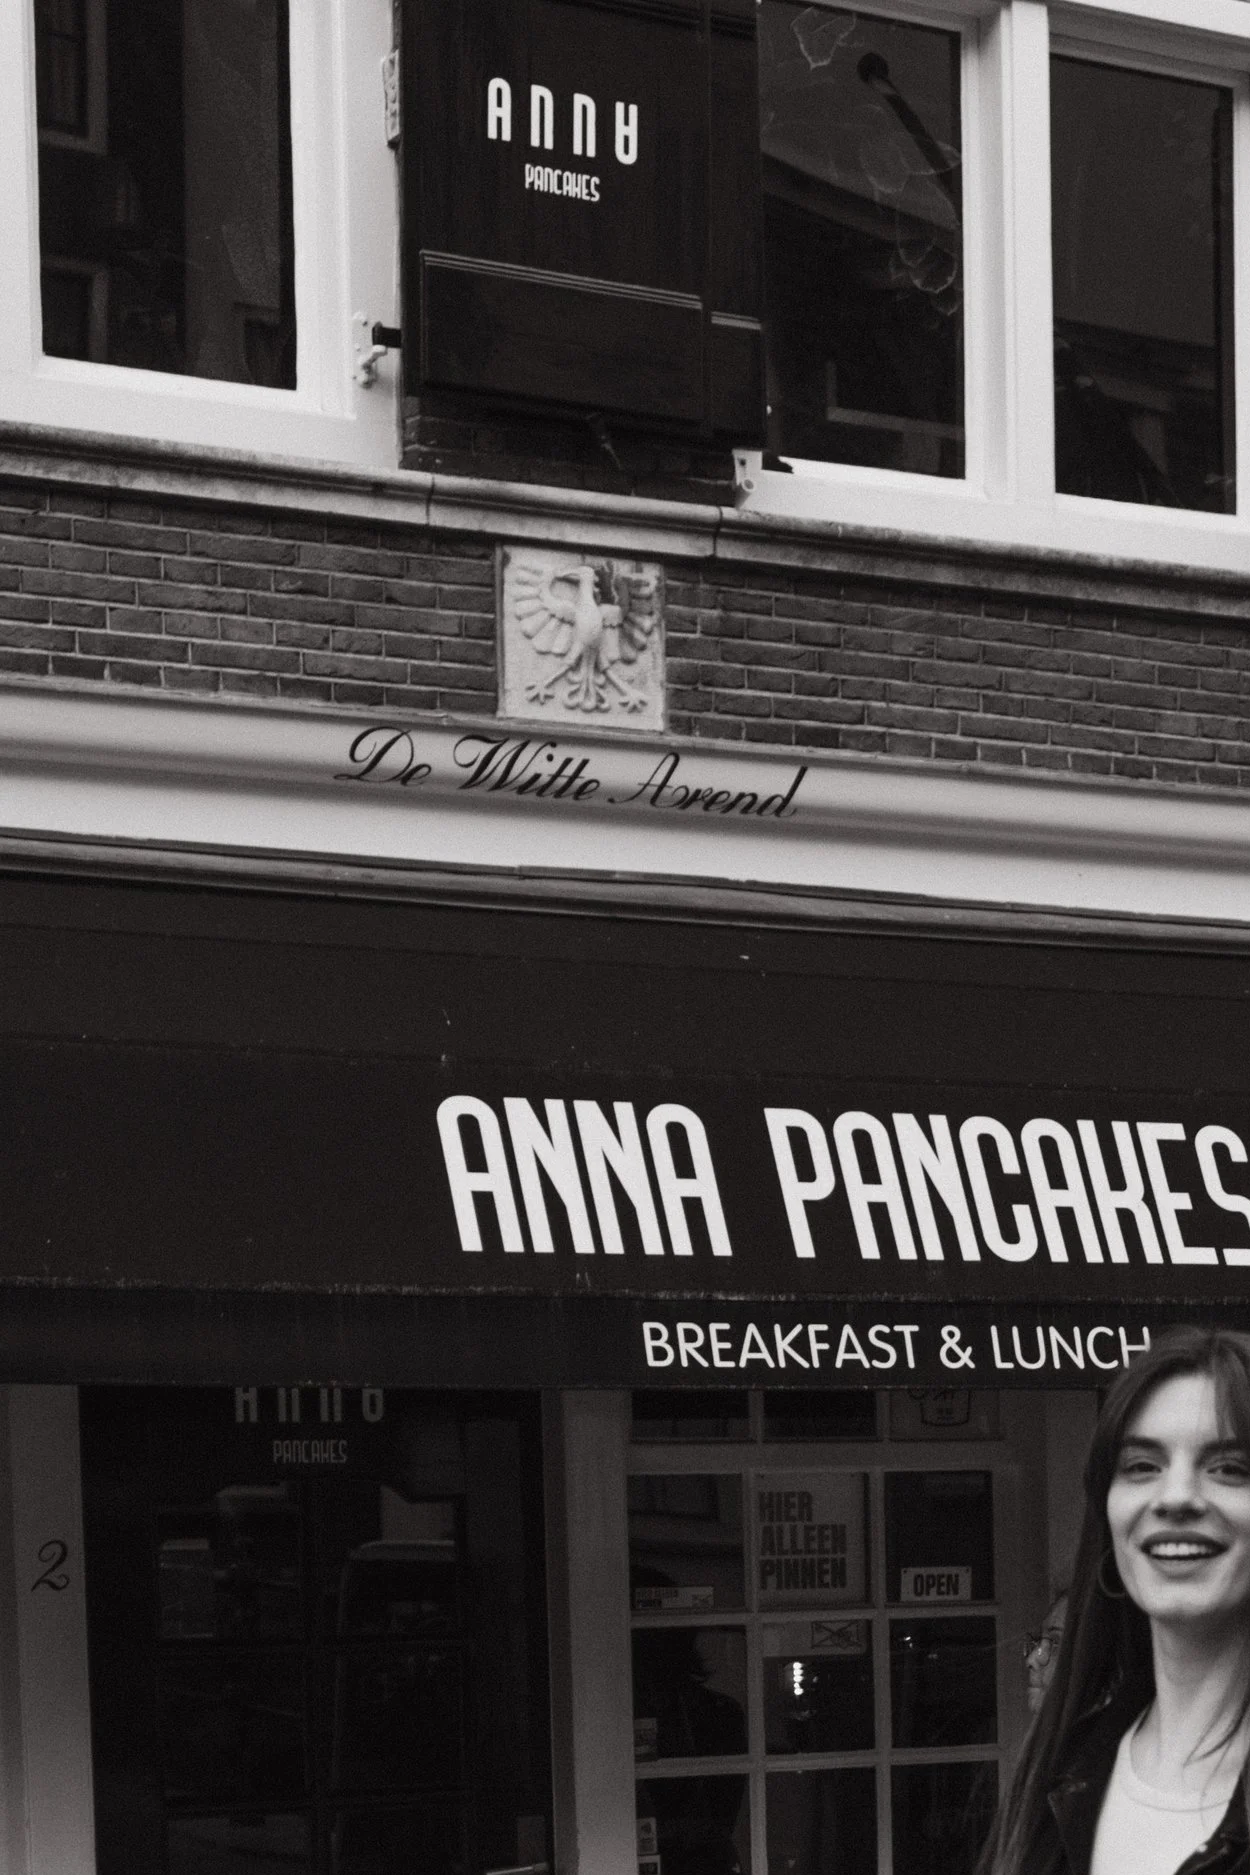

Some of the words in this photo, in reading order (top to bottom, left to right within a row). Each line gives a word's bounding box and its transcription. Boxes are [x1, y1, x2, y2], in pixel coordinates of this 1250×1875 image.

[525, 163, 600, 202] PANCAKES
[334, 726, 432, 787] De
[453, 733, 601, 801] Witte
[608, 752, 808, 818] Arend
[437, 1095, 733, 1257] ANNA
[642, 1322, 920, 1369] BREAKFAST
[939, 1325, 976, 1369] &
[990, 1325, 1151, 1369] LUNCH
[272, 1439, 349, 1465] PANCAKES
[759, 1491, 814, 1522] HIER
[761, 1523, 847, 1555] ALLEEN
[30, 1539, 70, 1593] 2
[761, 1556, 847, 1589] PINNEN
[913, 1573, 960, 1597] OPEN
